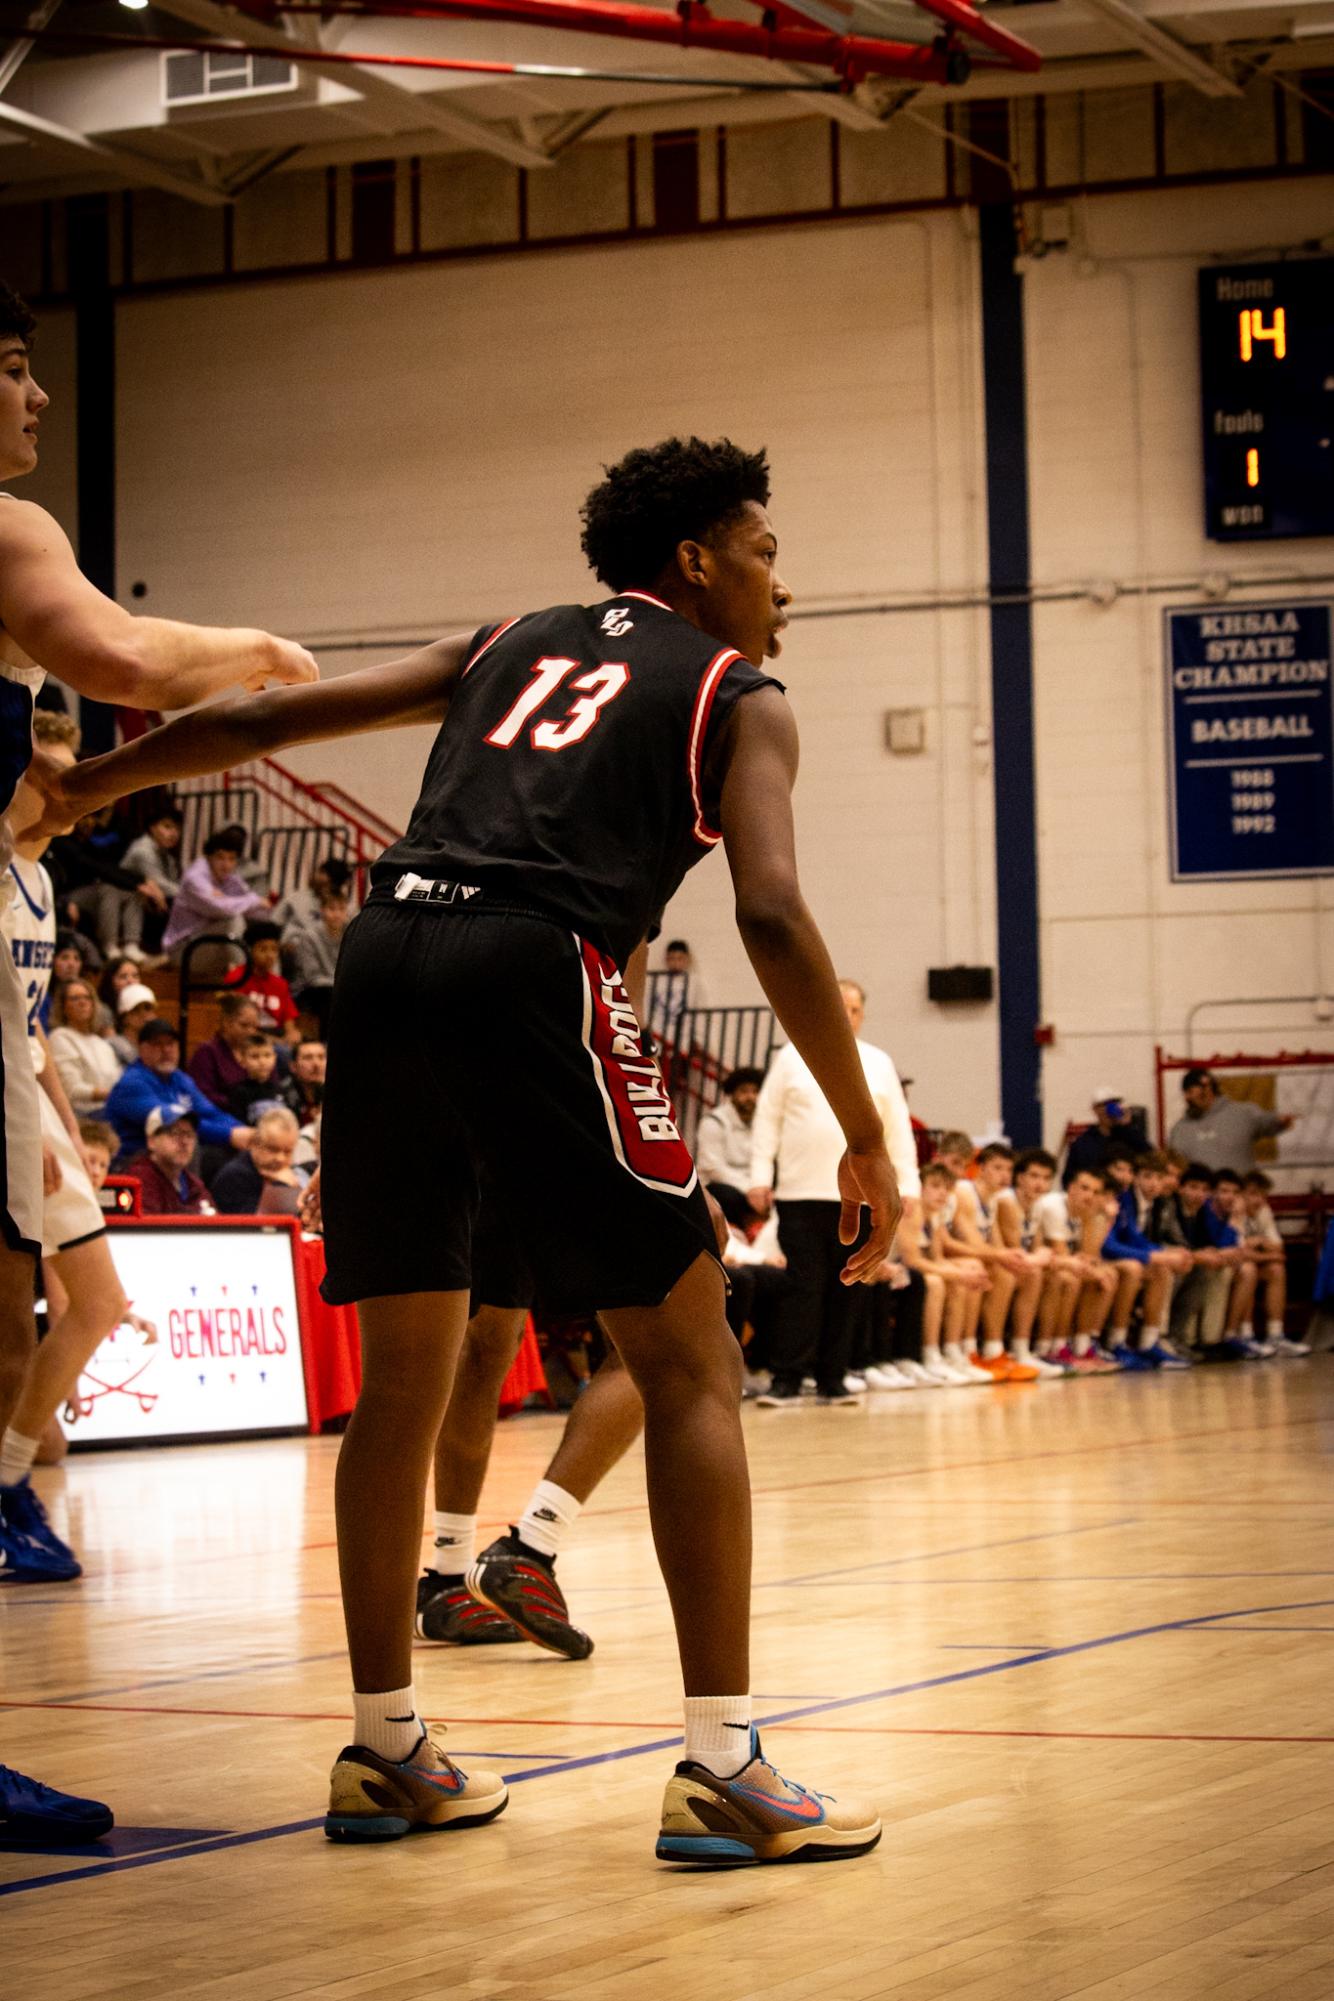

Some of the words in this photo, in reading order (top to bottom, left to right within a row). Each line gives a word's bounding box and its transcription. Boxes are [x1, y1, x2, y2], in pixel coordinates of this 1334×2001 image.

[1239, 307, 1286, 362] 14
[1246, 448, 1259, 487] 1
[1205, 636, 1295, 662] STATE
[1174, 660, 1328, 689] CHAMPION
[483, 655, 631, 752] 13
[1192, 716, 1313, 742] BASEBALL
[1232, 815, 1276, 834] 1992
[168, 1306, 287, 1359] GENERALS
